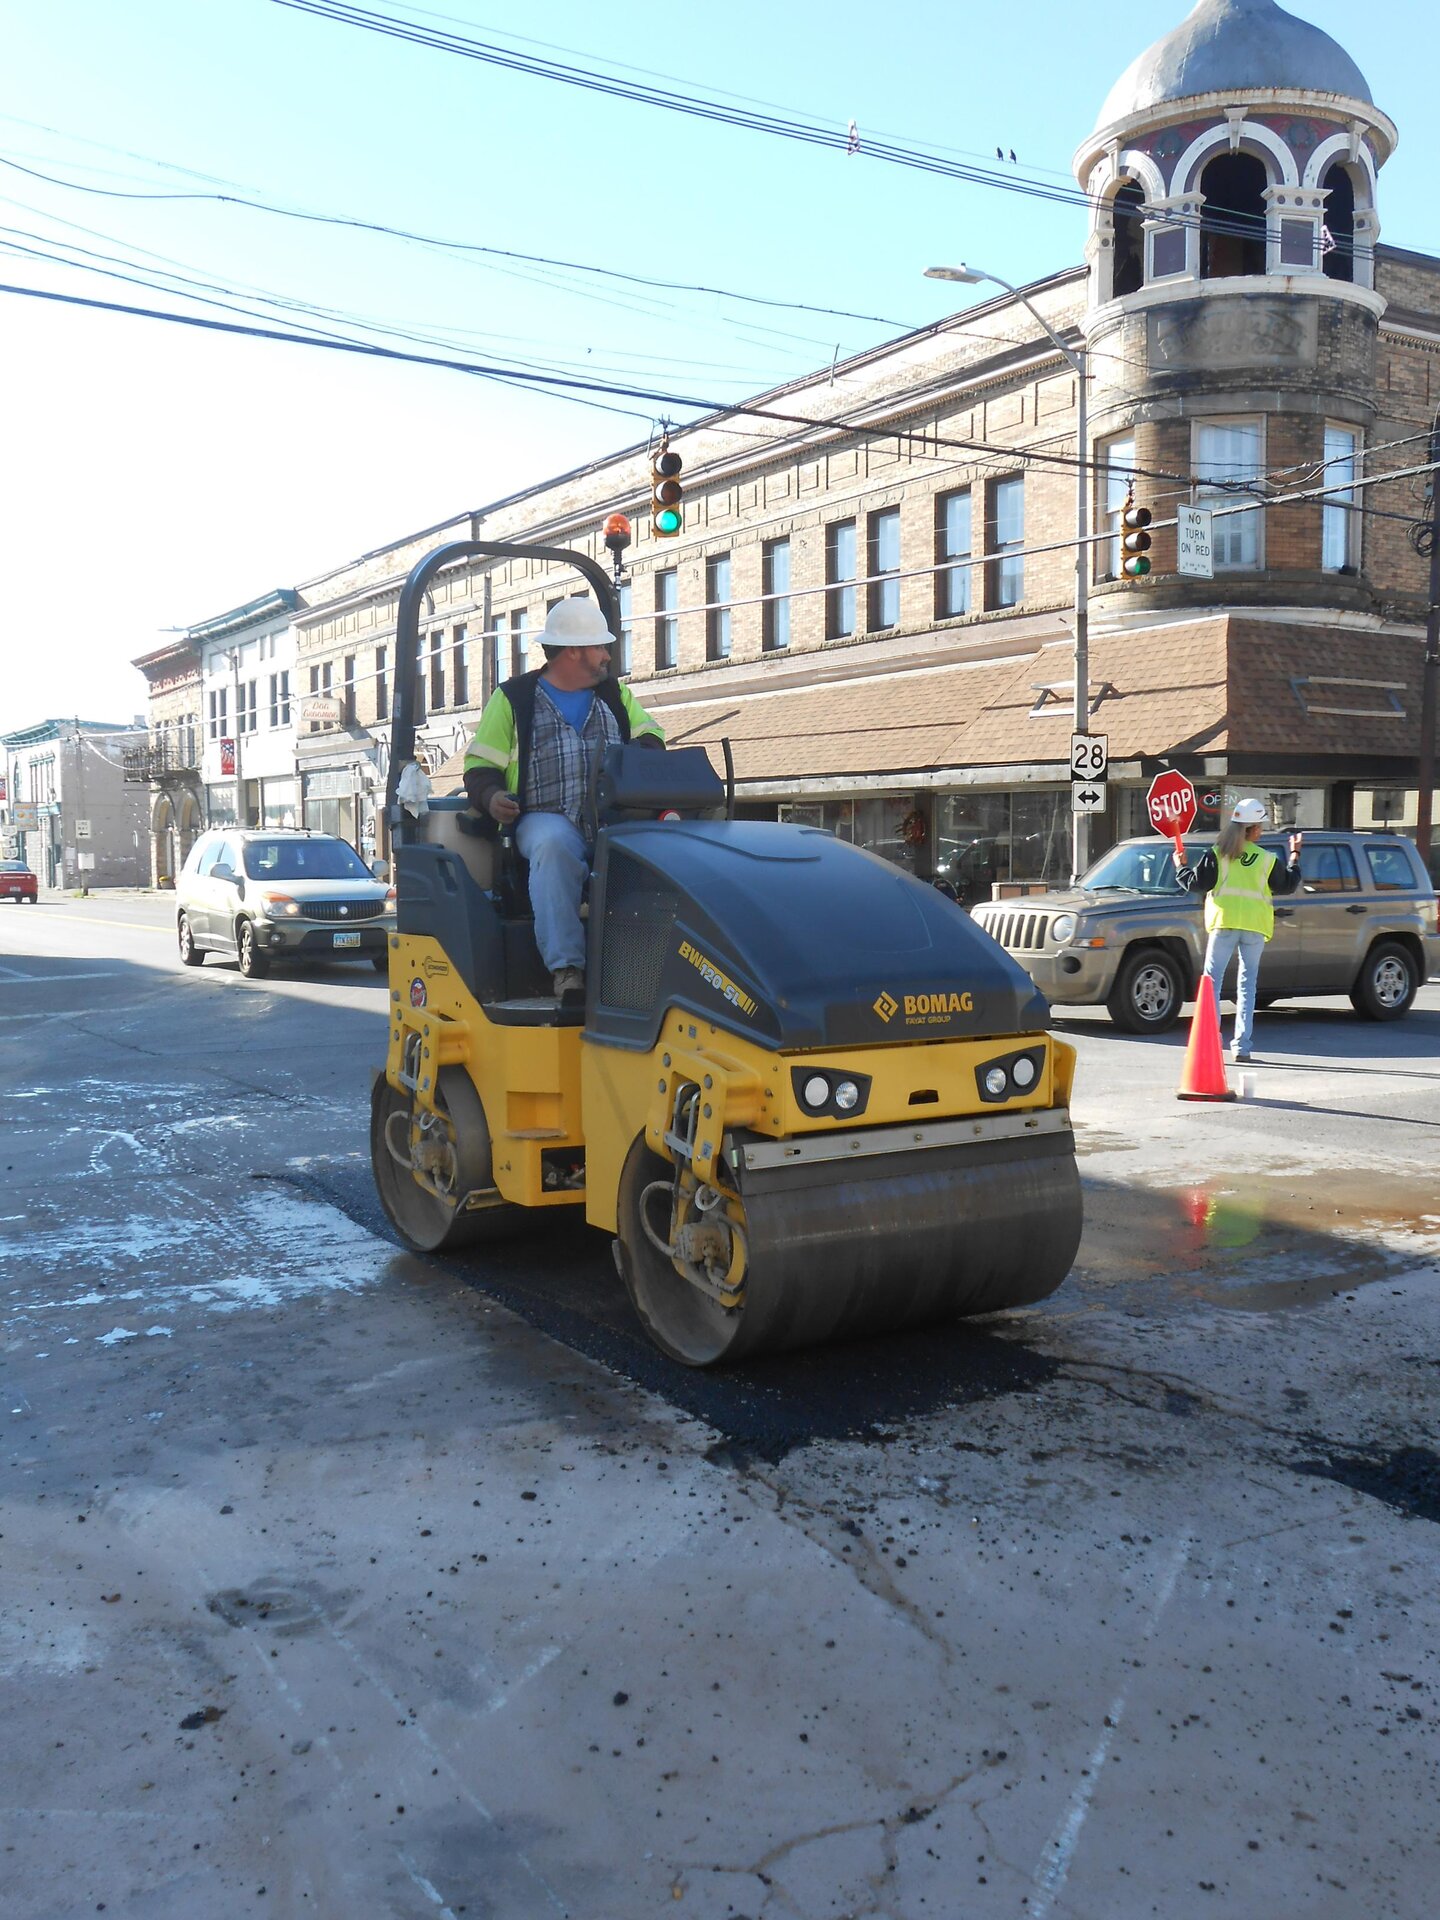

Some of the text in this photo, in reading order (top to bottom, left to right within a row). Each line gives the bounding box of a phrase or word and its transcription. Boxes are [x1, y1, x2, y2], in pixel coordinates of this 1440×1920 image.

[1188, 513, 1202, 525] NO
[1185, 527, 1206, 541] TURN
[1181, 542, 1210, 557] ON RED
[1074, 743, 1104, 769] 28
[1151, 788, 1192, 822] STOP
[1203, 793, 1238, 805] OPEN
[678, 940, 740, 1007] BW 120 SL
[903, 992, 973, 1015] BOMAG
[905, 1015, 951, 1025] FAYAT GROUP
